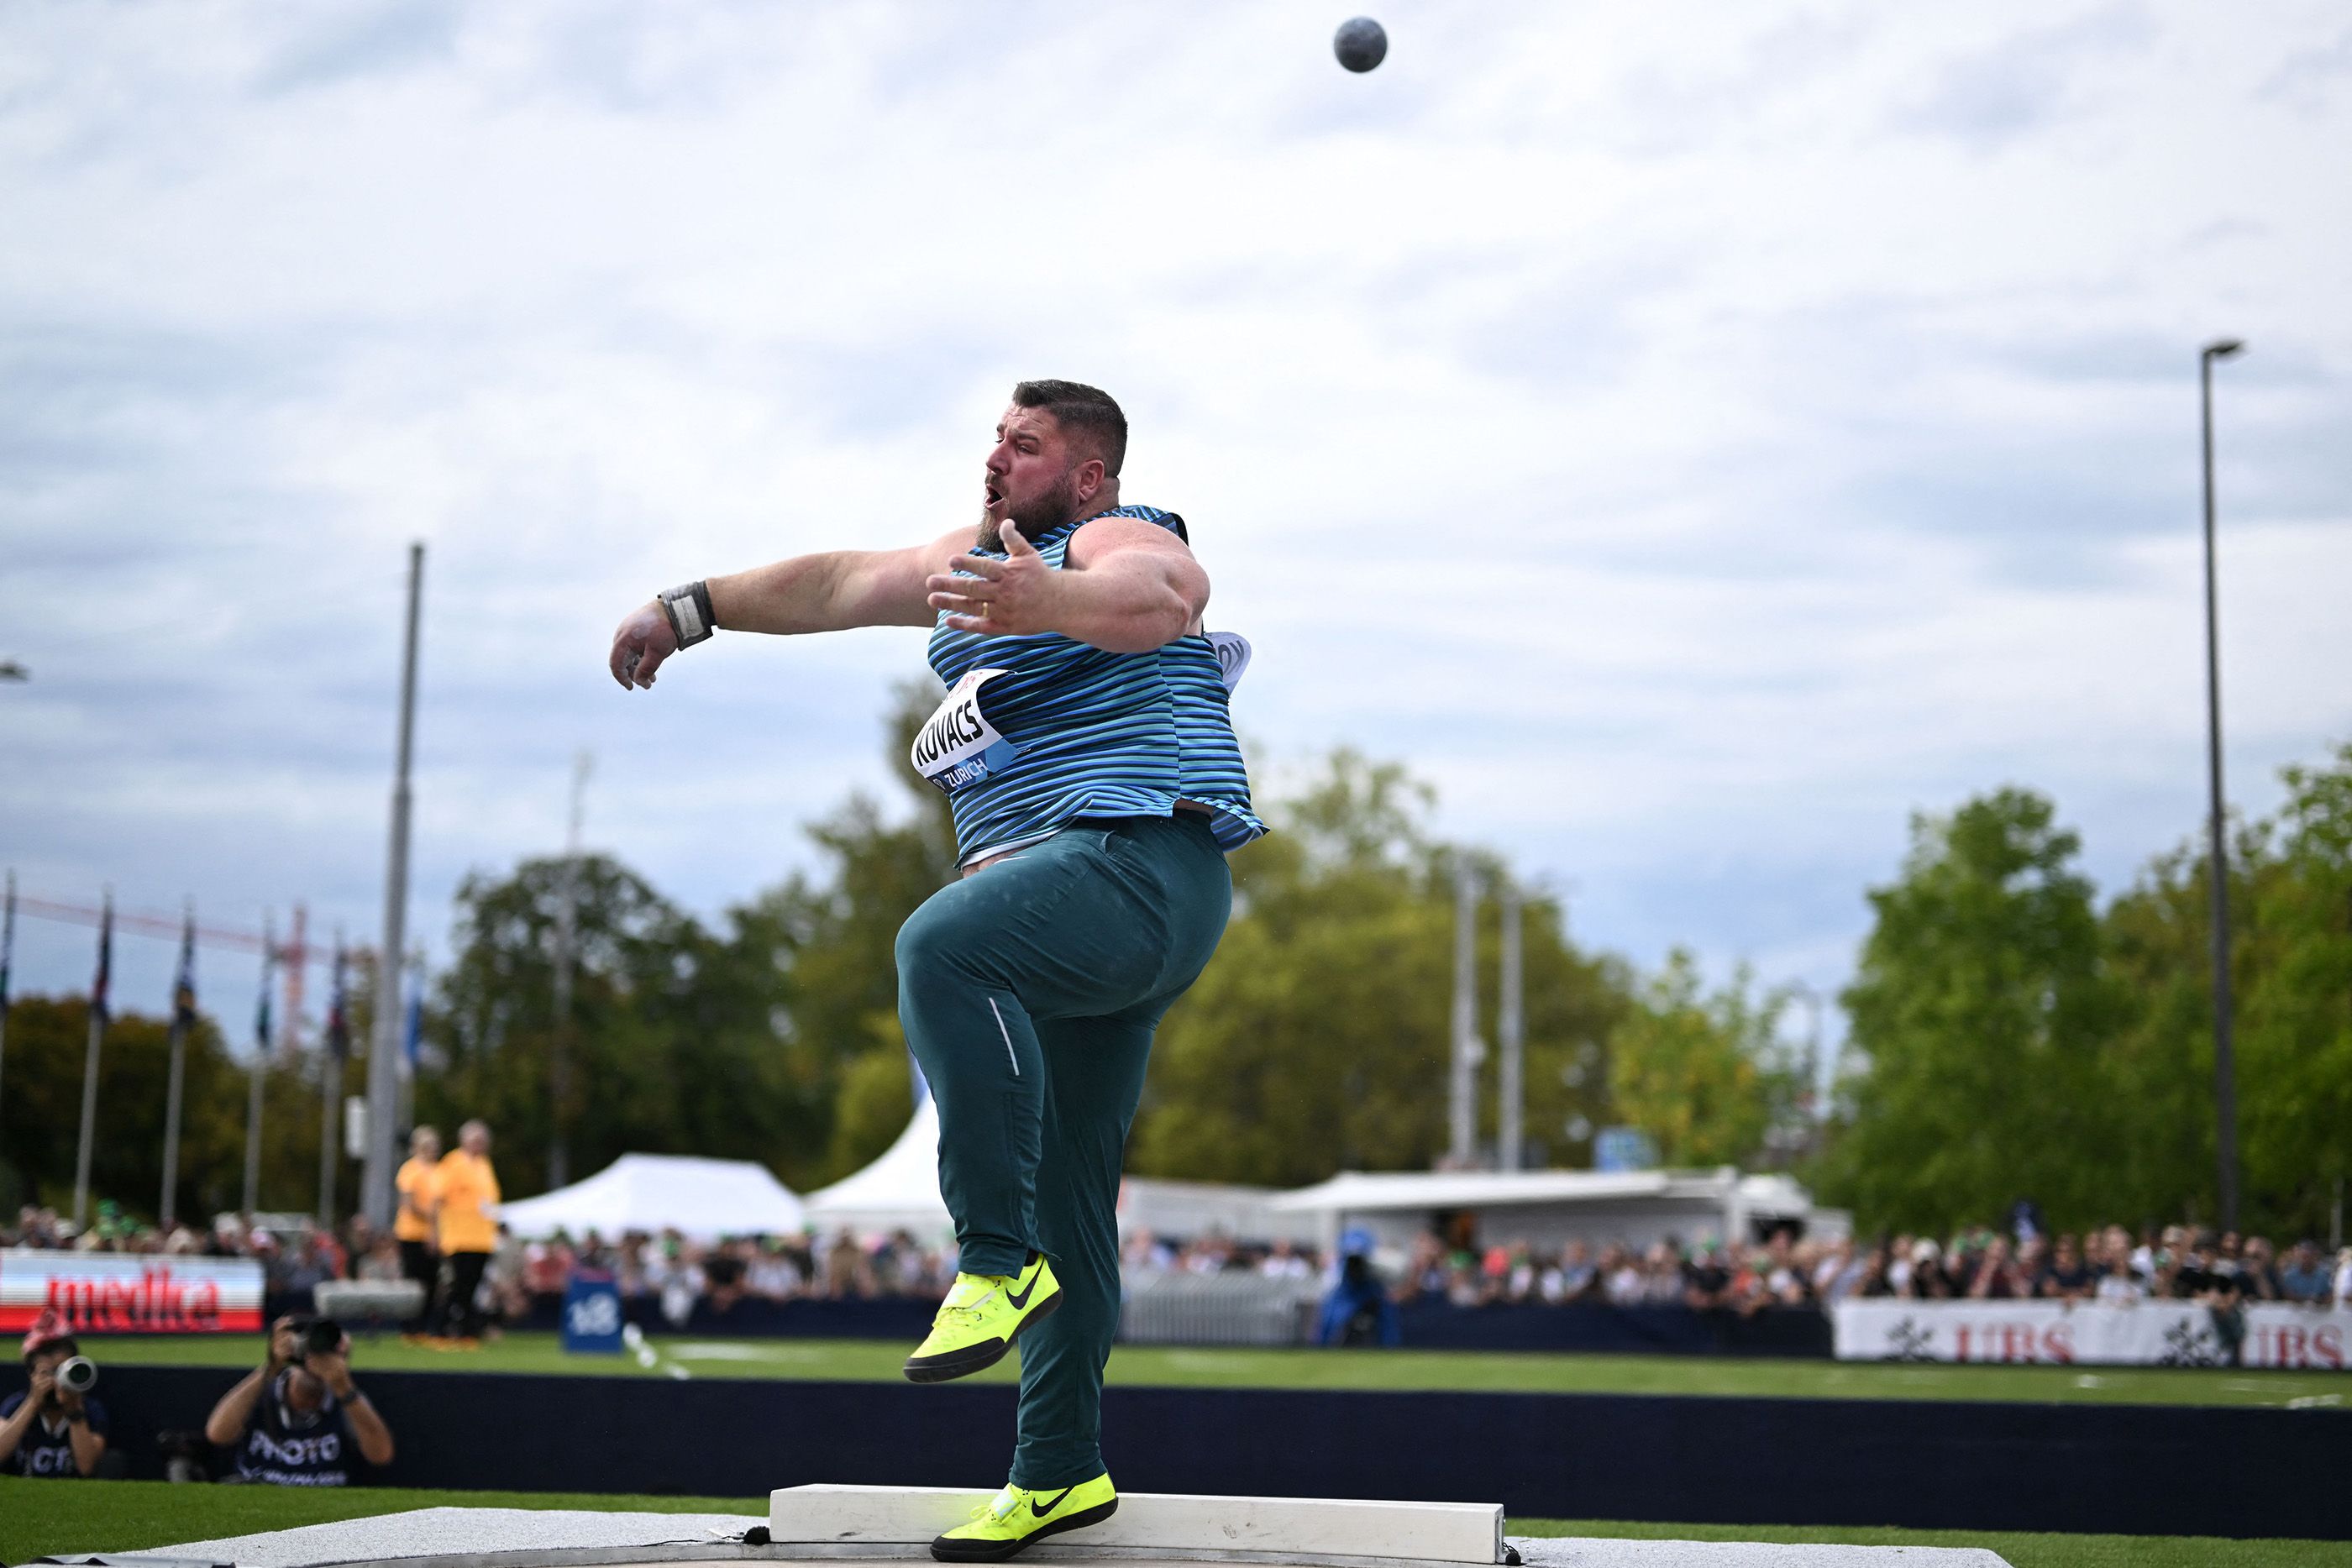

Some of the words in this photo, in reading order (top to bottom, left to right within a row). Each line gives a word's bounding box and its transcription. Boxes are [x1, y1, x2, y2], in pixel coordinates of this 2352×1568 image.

[916, 699, 984, 767] KOVACS
[944, 758, 989, 788] ZURICH
[1956, 1321, 2076, 1363] UBS
